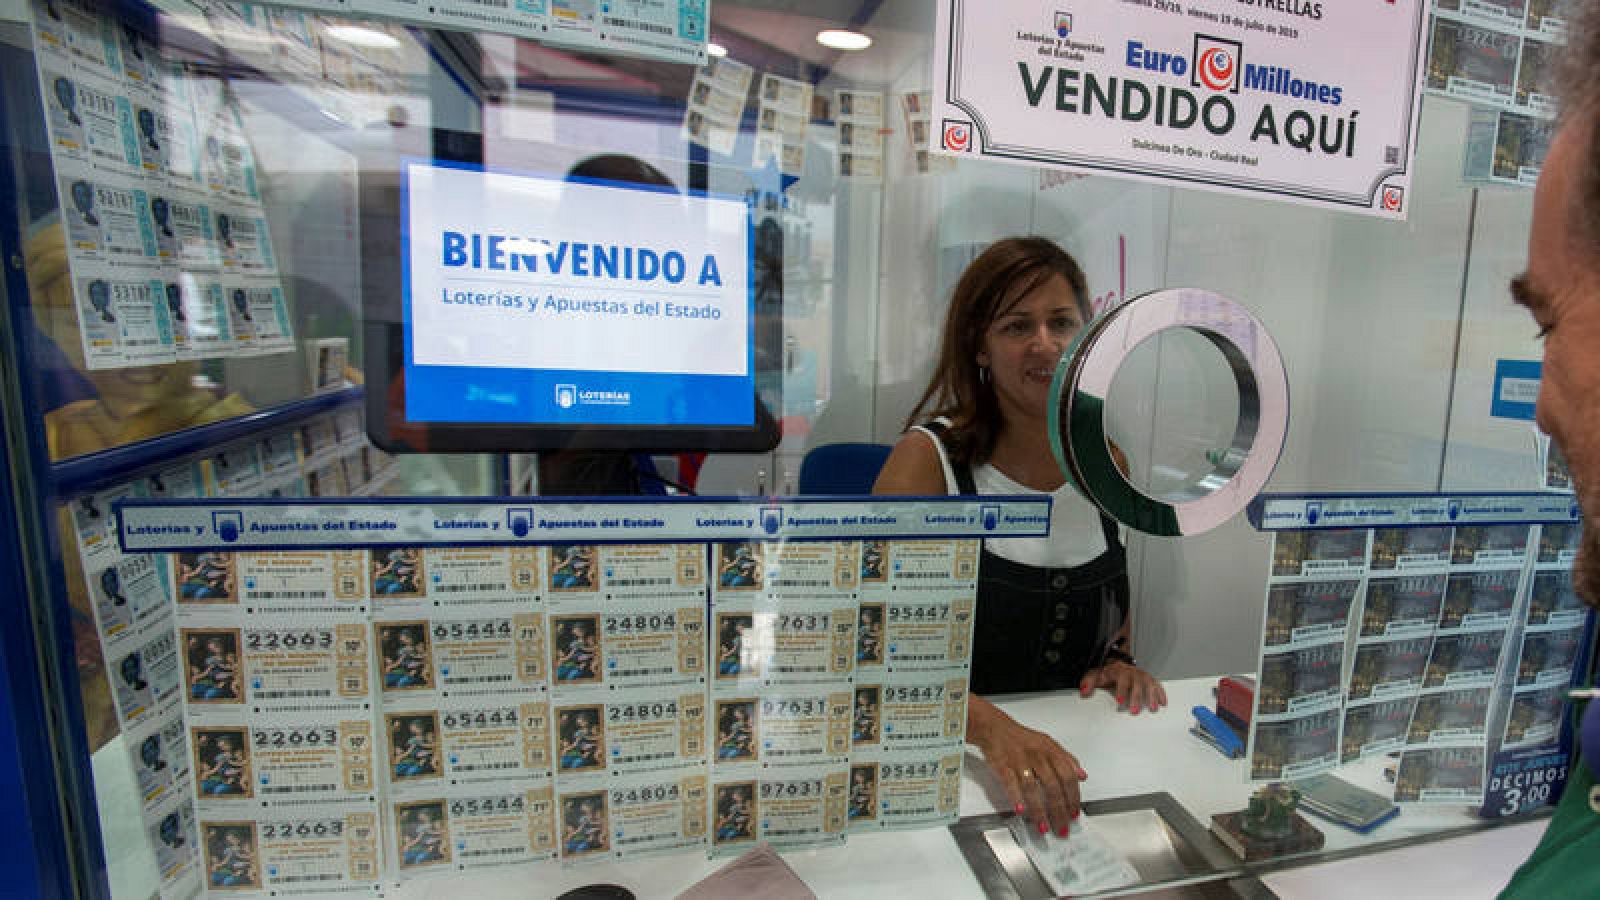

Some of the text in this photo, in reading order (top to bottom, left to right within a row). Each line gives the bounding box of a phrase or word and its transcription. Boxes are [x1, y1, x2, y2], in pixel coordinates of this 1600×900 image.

[1126, 39, 1343, 105] Euro Millones
[1018, 61, 1360, 159] VENDIDO AQUÍ
[442, 230, 723, 287] BIENVENIDO A
[442, 287, 721, 320] Loterías y Apuestas del Estado
[776, 614, 829, 632] 7631
[889, 606, 949, 622] 95447
[433, 621, 512, 640] 65444
[605, 615, 677, 634] 24804
[247, 631, 334, 651] 22663
[443, 710, 519, 729] 65444
[609, 703, 677, 721] 24804
[254, 729, 338, 749] 22663
[761, 781, 822, 799] 97631
[262, 821, 344, 839] 22663
